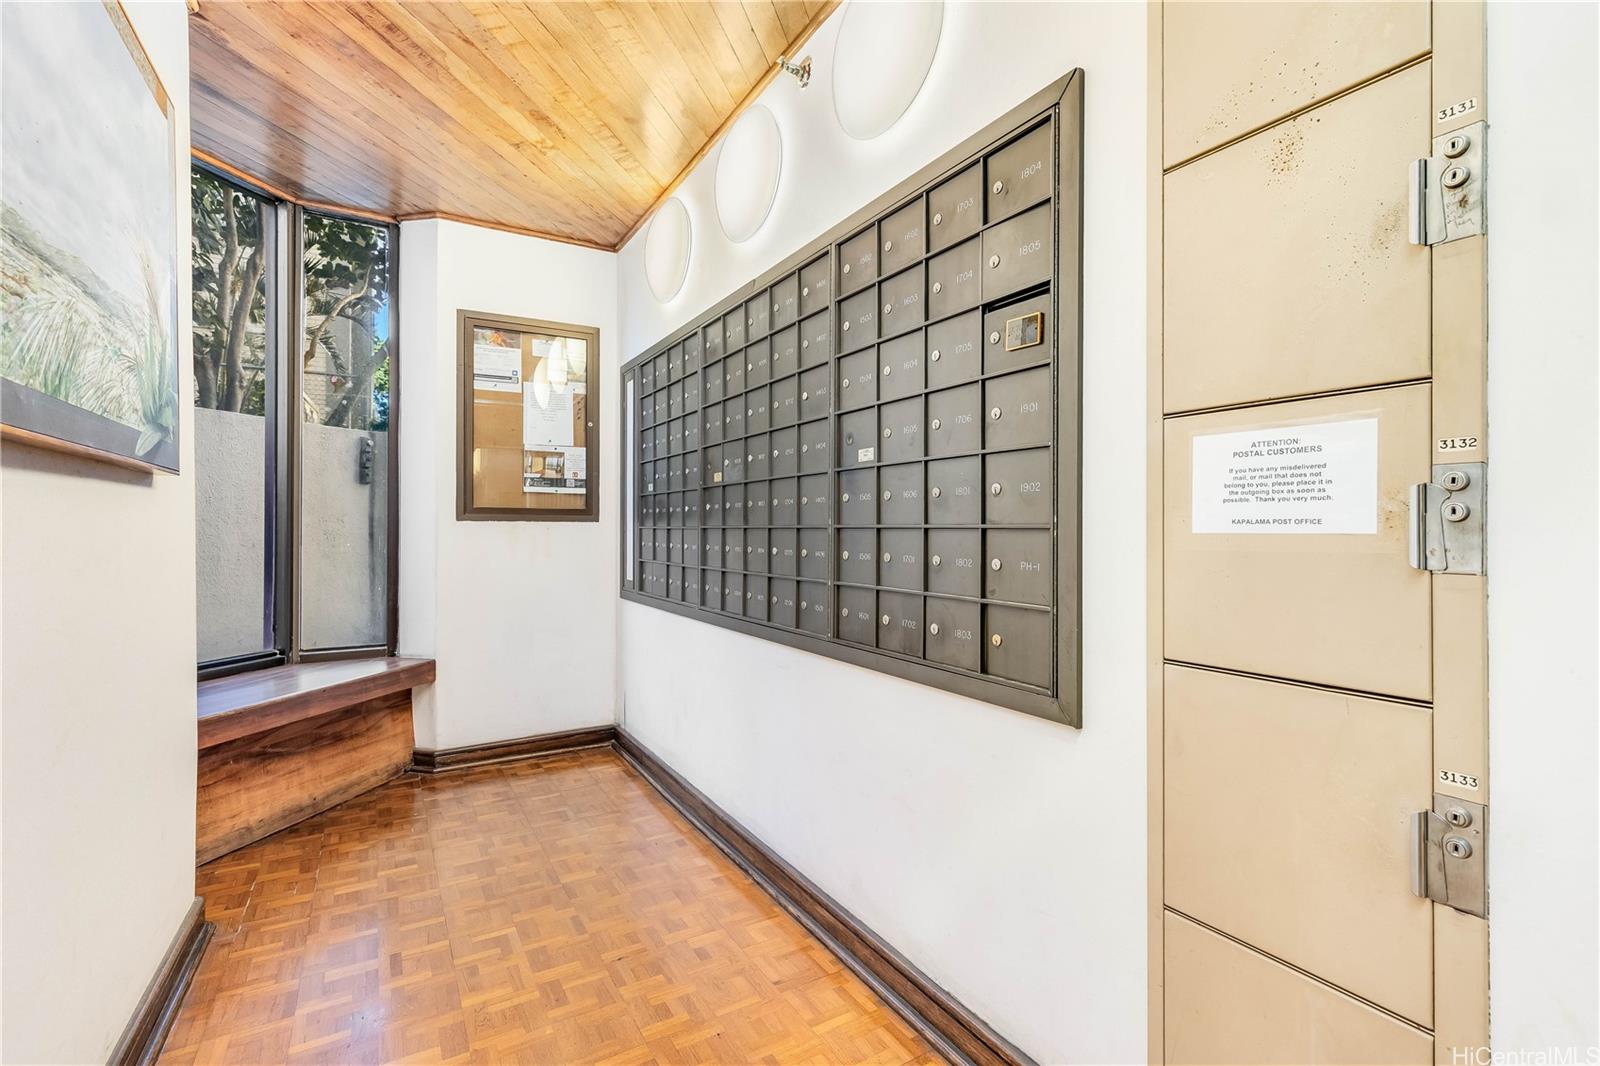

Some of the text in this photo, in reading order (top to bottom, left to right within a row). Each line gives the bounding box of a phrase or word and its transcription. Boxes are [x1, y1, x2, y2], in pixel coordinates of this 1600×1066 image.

[1439, 99, 1476, 120] 3131
[1021, 161, 1042, 179] 1804
[957, 198, 974, 212] 1703
[1019, 240, 1041, 256] 1805
[956, 270, 973, 284] 1704
[956, 342, 972, 353] 1705
[903, 359, 918, 370] 1604
[1020, 403, 1039, 413] 1901
[955, 414, 972, 425] 1706
[1251, 438, 1301, 448] ATTENTION:
[1439, 437, 1477, 449] 3132
[1233, 445, 1322, 458] POSTAL CUSTOMERS
[1280, 463, 1326, 471] misdelivered
[955, 486, 970, 496] 1801
[1020, 482, 1040, 492] 1902
[955, 558, 973, 568] 1802
[902, 620, 916, 630] 1702
[954, 629, 972, 640] 1803
[1440, 770, 1478, 788] 3133
